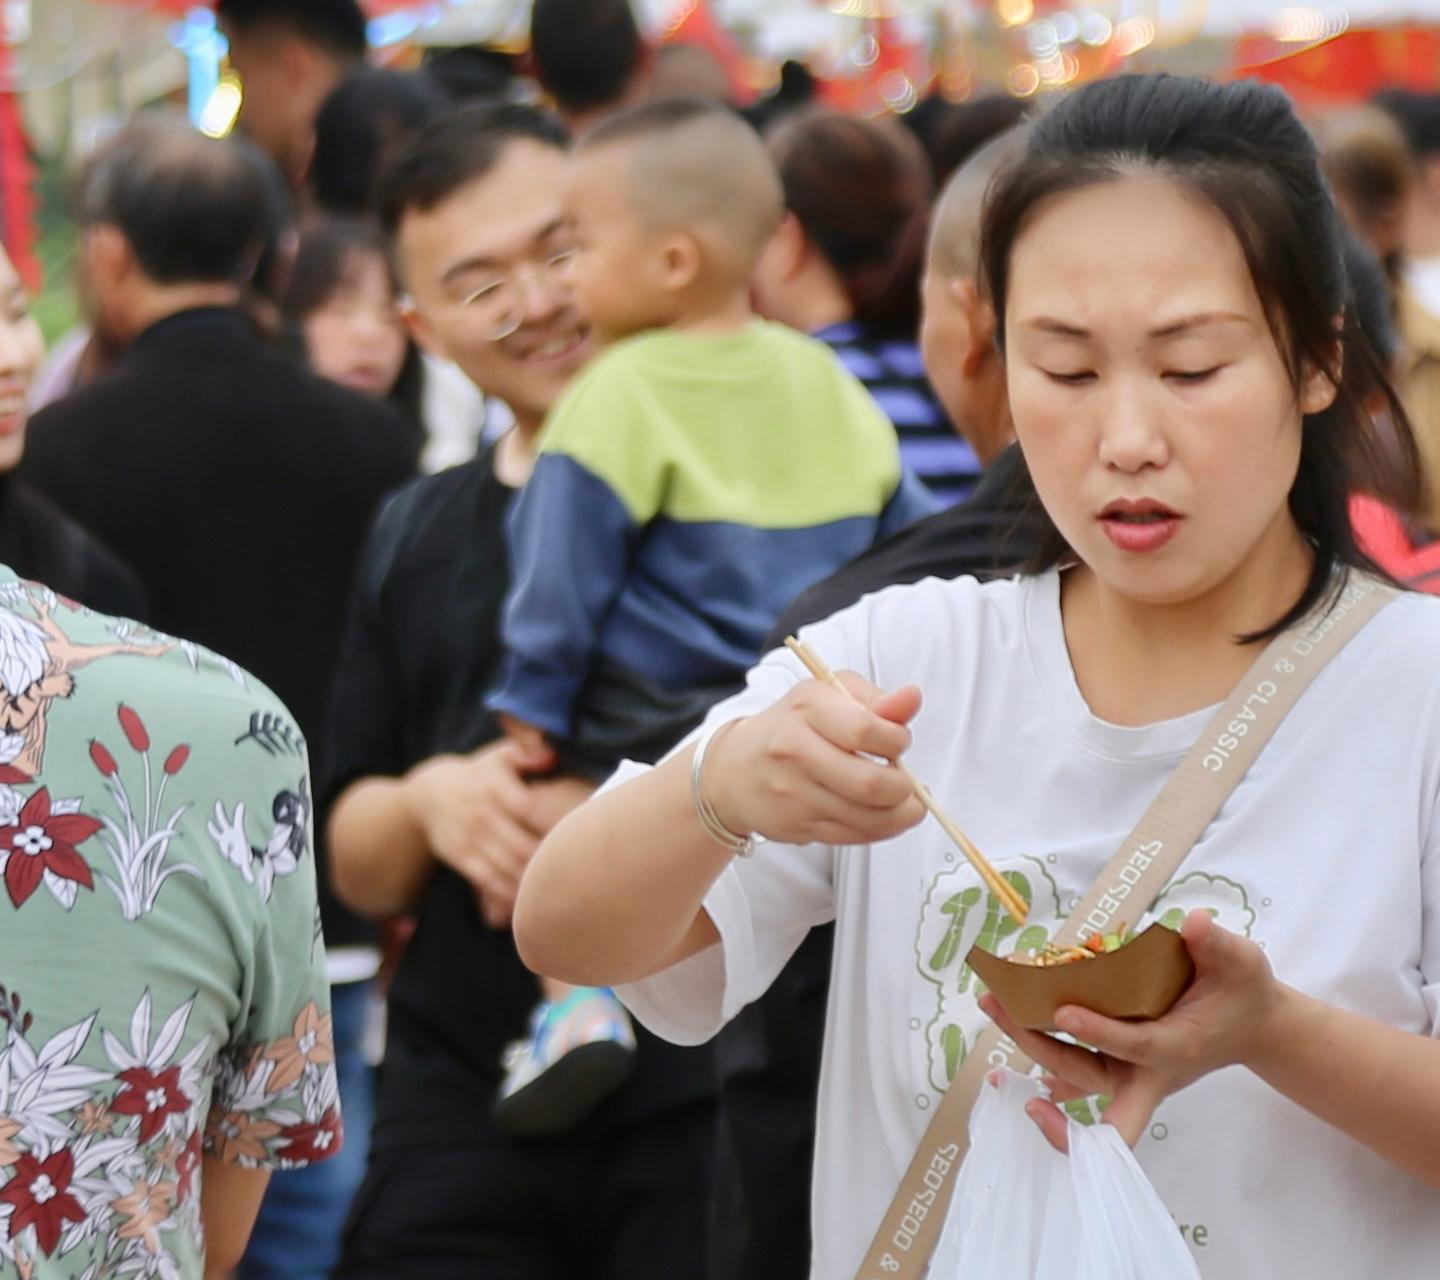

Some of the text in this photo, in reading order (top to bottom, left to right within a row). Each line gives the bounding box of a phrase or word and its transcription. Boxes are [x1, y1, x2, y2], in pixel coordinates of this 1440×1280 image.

[1272, 658, 1295, 673] &
[1203, 681, 1276, 772] CLASSIC
[879, 1253, 900, 1273] &
